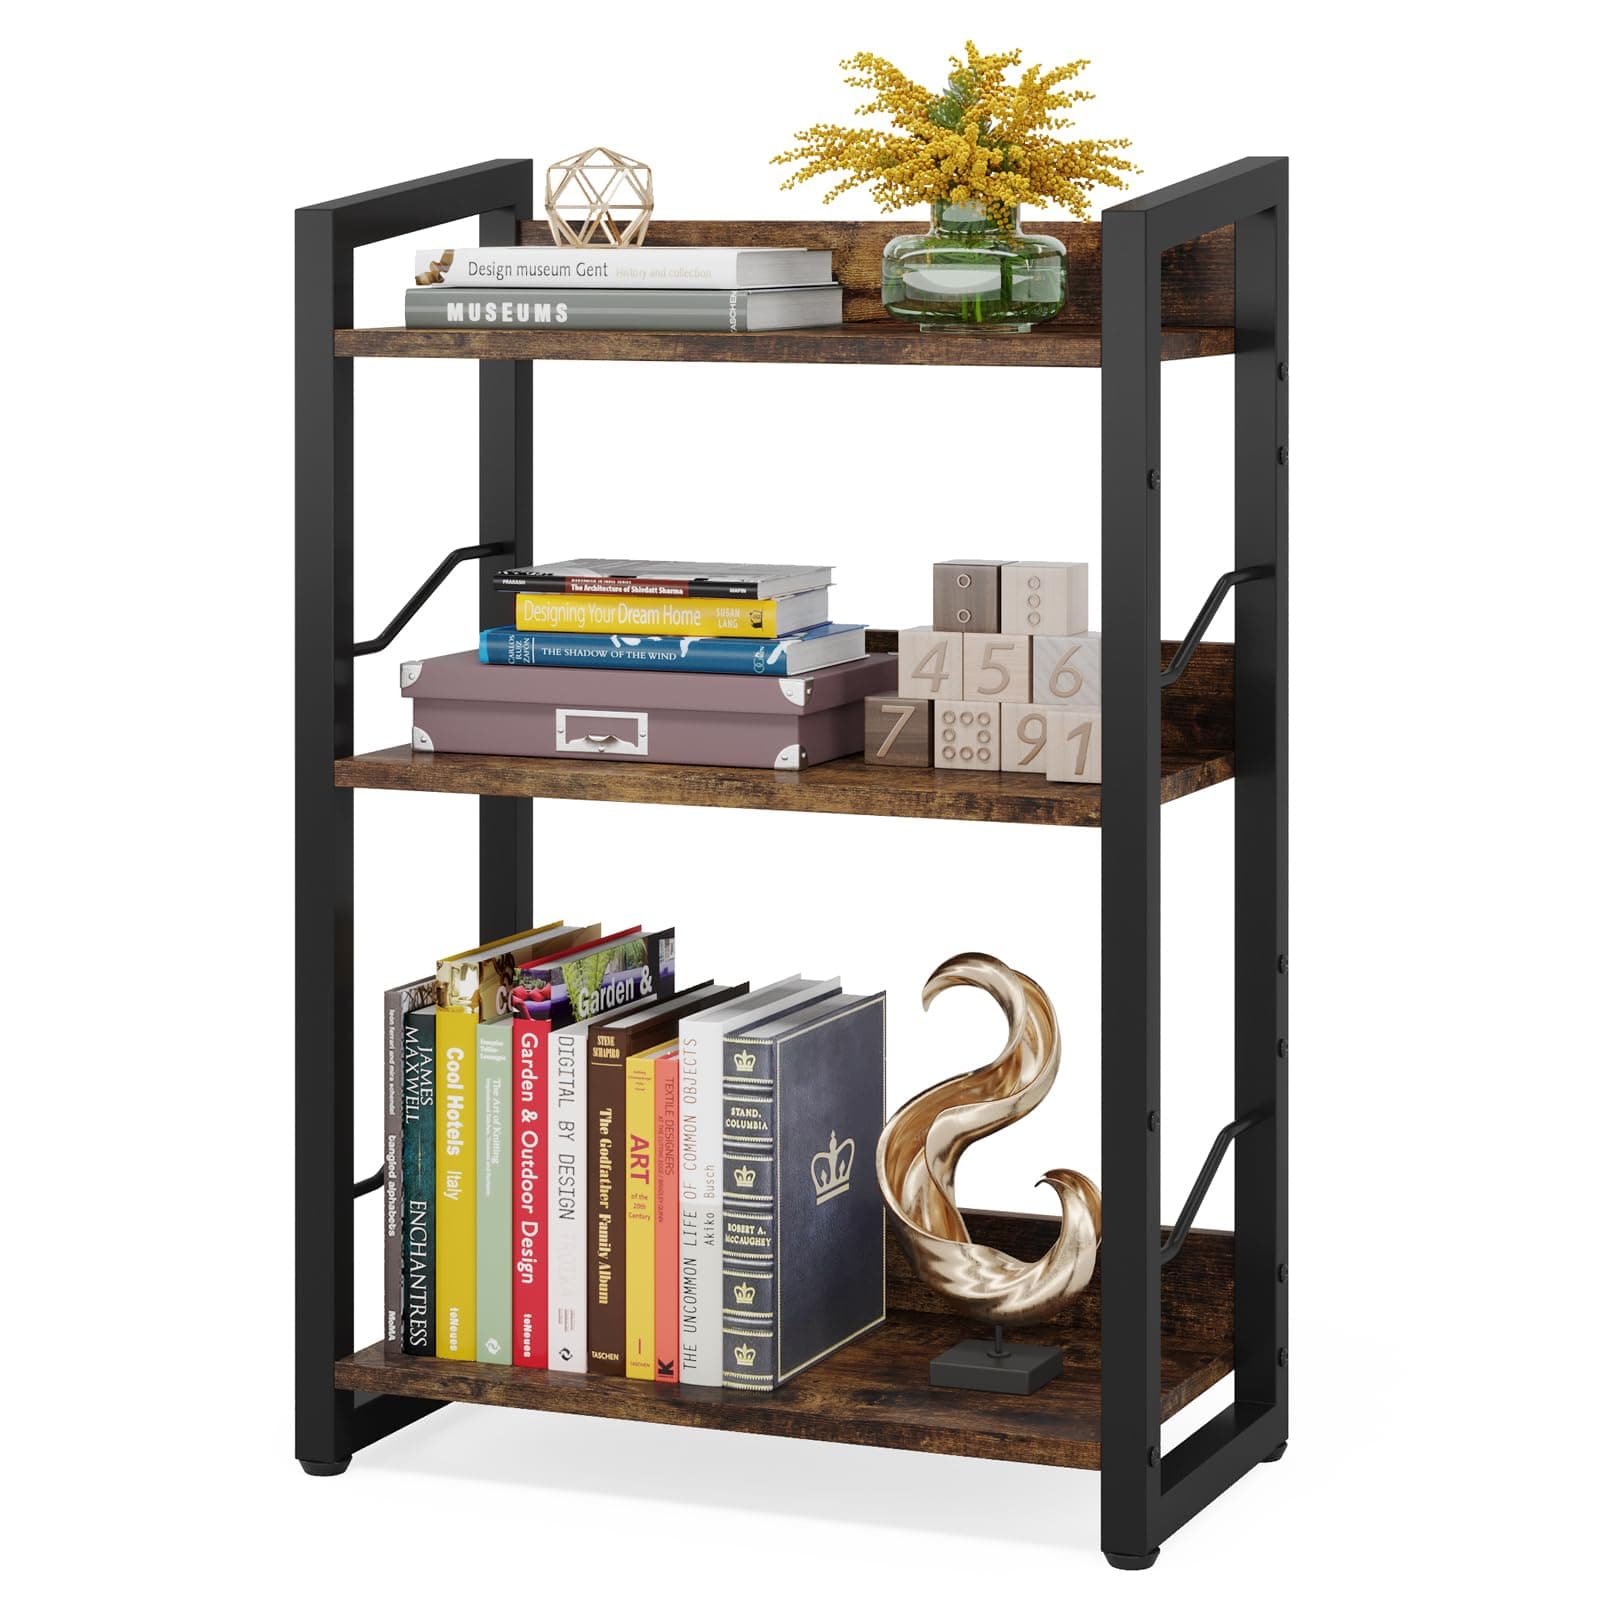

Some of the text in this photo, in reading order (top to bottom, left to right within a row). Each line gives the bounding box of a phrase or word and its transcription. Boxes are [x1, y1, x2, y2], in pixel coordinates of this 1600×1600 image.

[468, 261, 512, 280] Design
[516, 263, 571, 277] museum
[576, 262, 609, 277] Gent
[446, 302, 568, 323] MUSEUMS
[523, 600, 701, 628] Designing Your Dream Home
[571, 583, 583, 591] The
[584, 584, 622, 592] Architecture
[623, 585, 631, 593] of
[716, 607, 740, 618] SUSAN
[718, 619, 738, 629] LANG
[541, 647, 677, 661] THE SHADOW OF THE WIND
[911, 639, 950, 693] 4
[976, 641, 1015, 695] 5
[1049, 644, 1083, 698] 6
[876, 704, 916, 758] 7
[1016, 713, 1048, 766] 9
[1066, 721, 1092, 775] 1
[578, 965, 652, 1018] Garden &
[592, 1047, 620, 1059] SCHAPIRO
[597, 1035, 615, 1046] STEVE
[405, 1026, 420, 1124] MAXWELL
[417, 1046, 434, 1106] JAMES
[558, 1036, 575, 1108] DIGITAL
[443, 1047, 464, 1200] Cool Hotels Italy
[558, 1120, 575, 1142] BY
[664, 1078, 675, 1176] TEXTILE DESIGNERS
[725, 1118, 769, 1130] COLUMBIA
[731, 1107, 762, 1118] STAND.
[517, 1032, 539, 1284] Garden & Outdoor Design
[630, 1133, 650, 1185] ART
[386, 1134, 397, 1237] tangled alphabets
[558, 1153, 576, 1220] DESIGN
[597, 1107, 613, 1304] The Godfather Family Album
[683, 1038, 697, 1370] THE UNCOMMON LIFE OF COMMON OBJECTS
[703, 1165, 715, 1247] Akiko Busch
[727, 1222, 767, 1235] ROBERT A.
[409, 1200, 427, 1347] ENCHANTRESS
[388, 1310, 397, 1341] MoMA
[591, 1350, 619, 1360] TASCHEN
